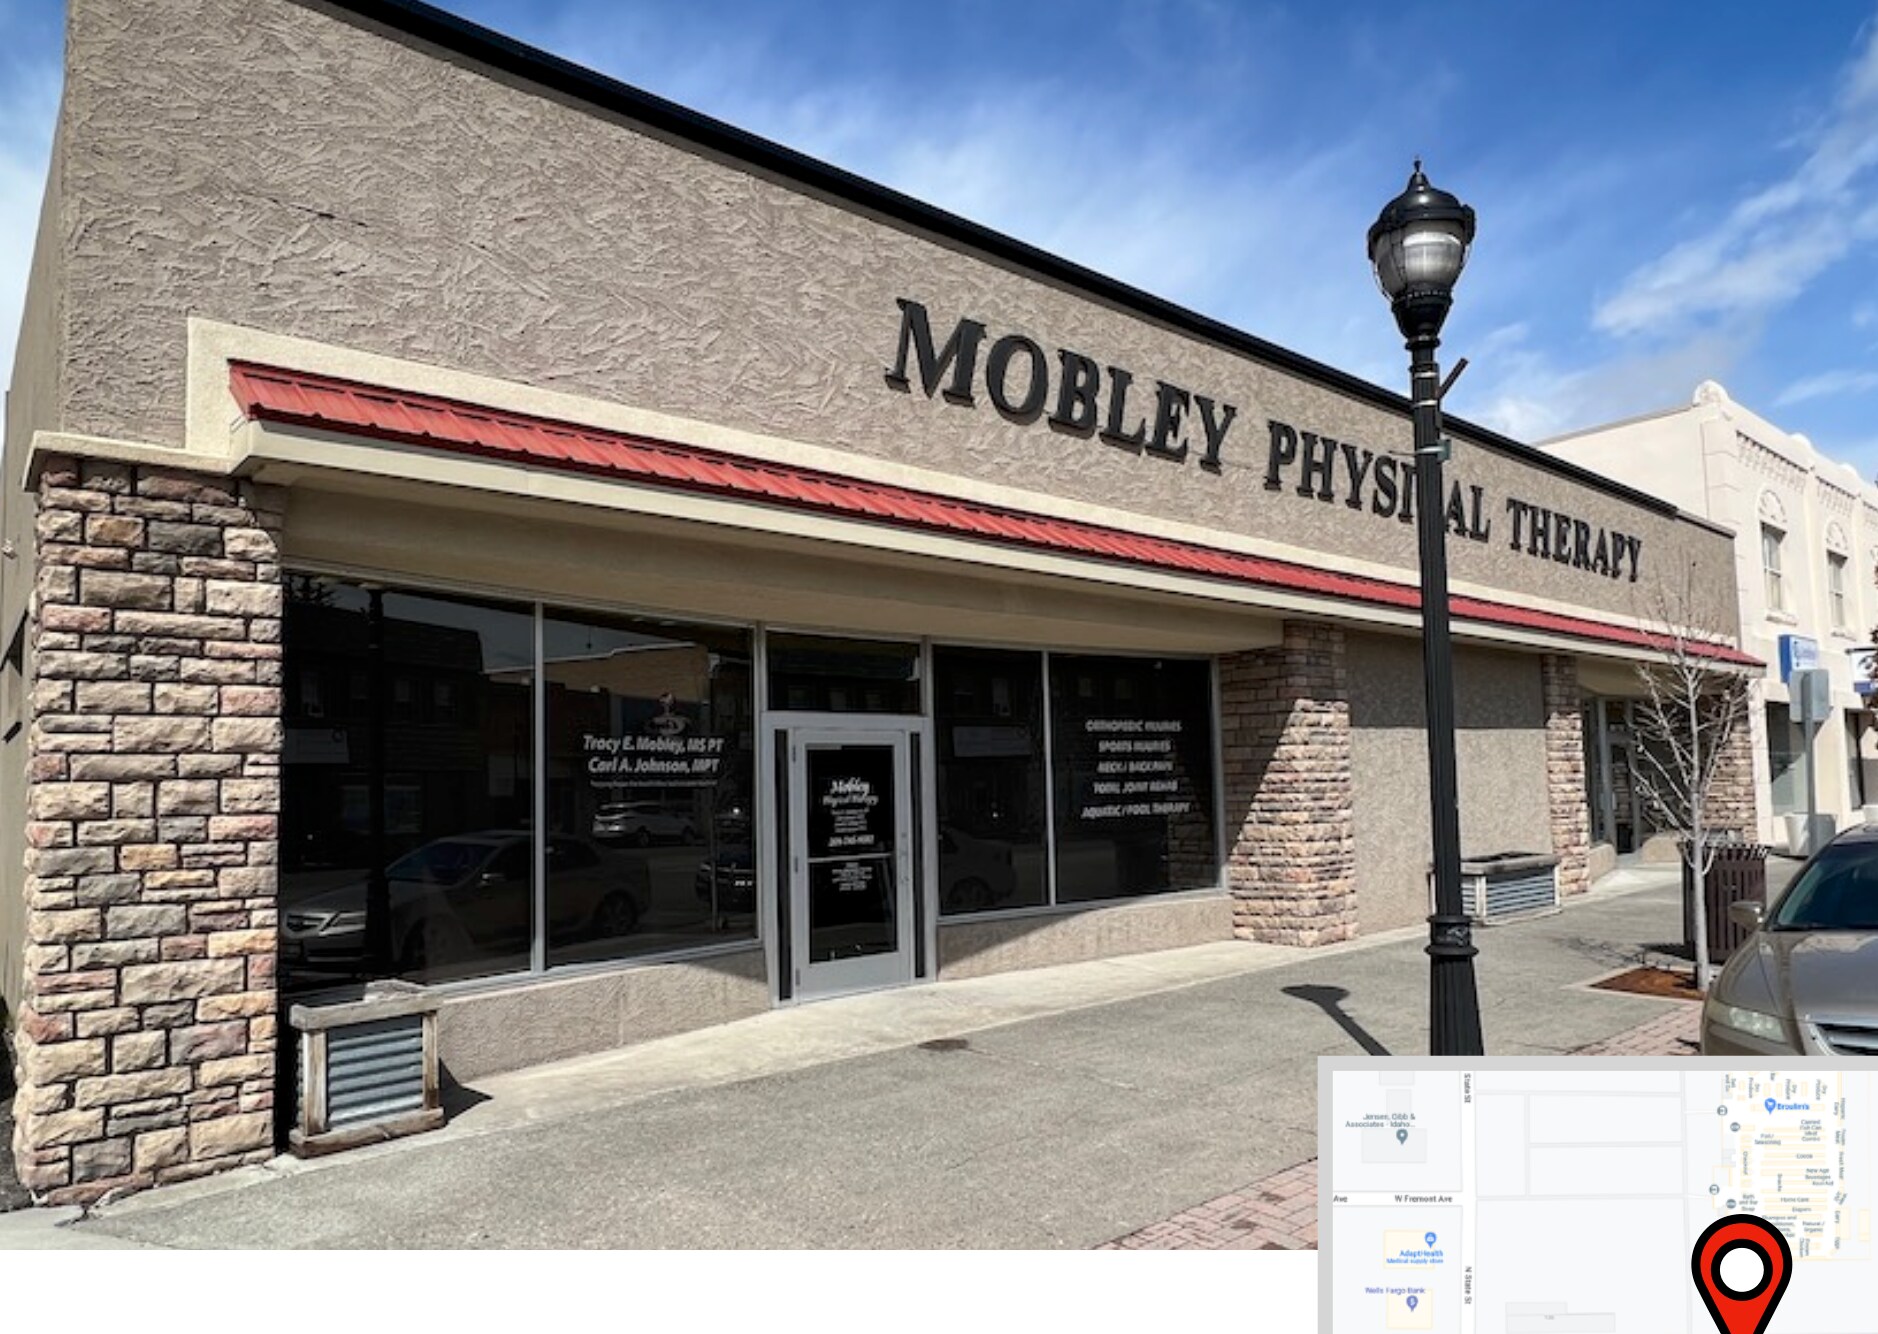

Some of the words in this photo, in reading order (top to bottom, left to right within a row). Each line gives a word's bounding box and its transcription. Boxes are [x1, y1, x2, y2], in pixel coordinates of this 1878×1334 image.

[884, 296, 1238, 477] MOBLEY
[1263, 418, 1492, 544] PHYSIAL
[1505, 497, 1643, 583] THERAPY
[583, 734, 622, 754] Tracy
[622, 736, 635, 750] E.
[635, 736, 687, 755] Mobley,
[707, 738, 725, 752] PT
[587, 756, 618, 773] Carl
[618, 756, 633, 772] A.
[633, 756, 691, 774] Johnson,
[691, 758, 720, 773] MPT
